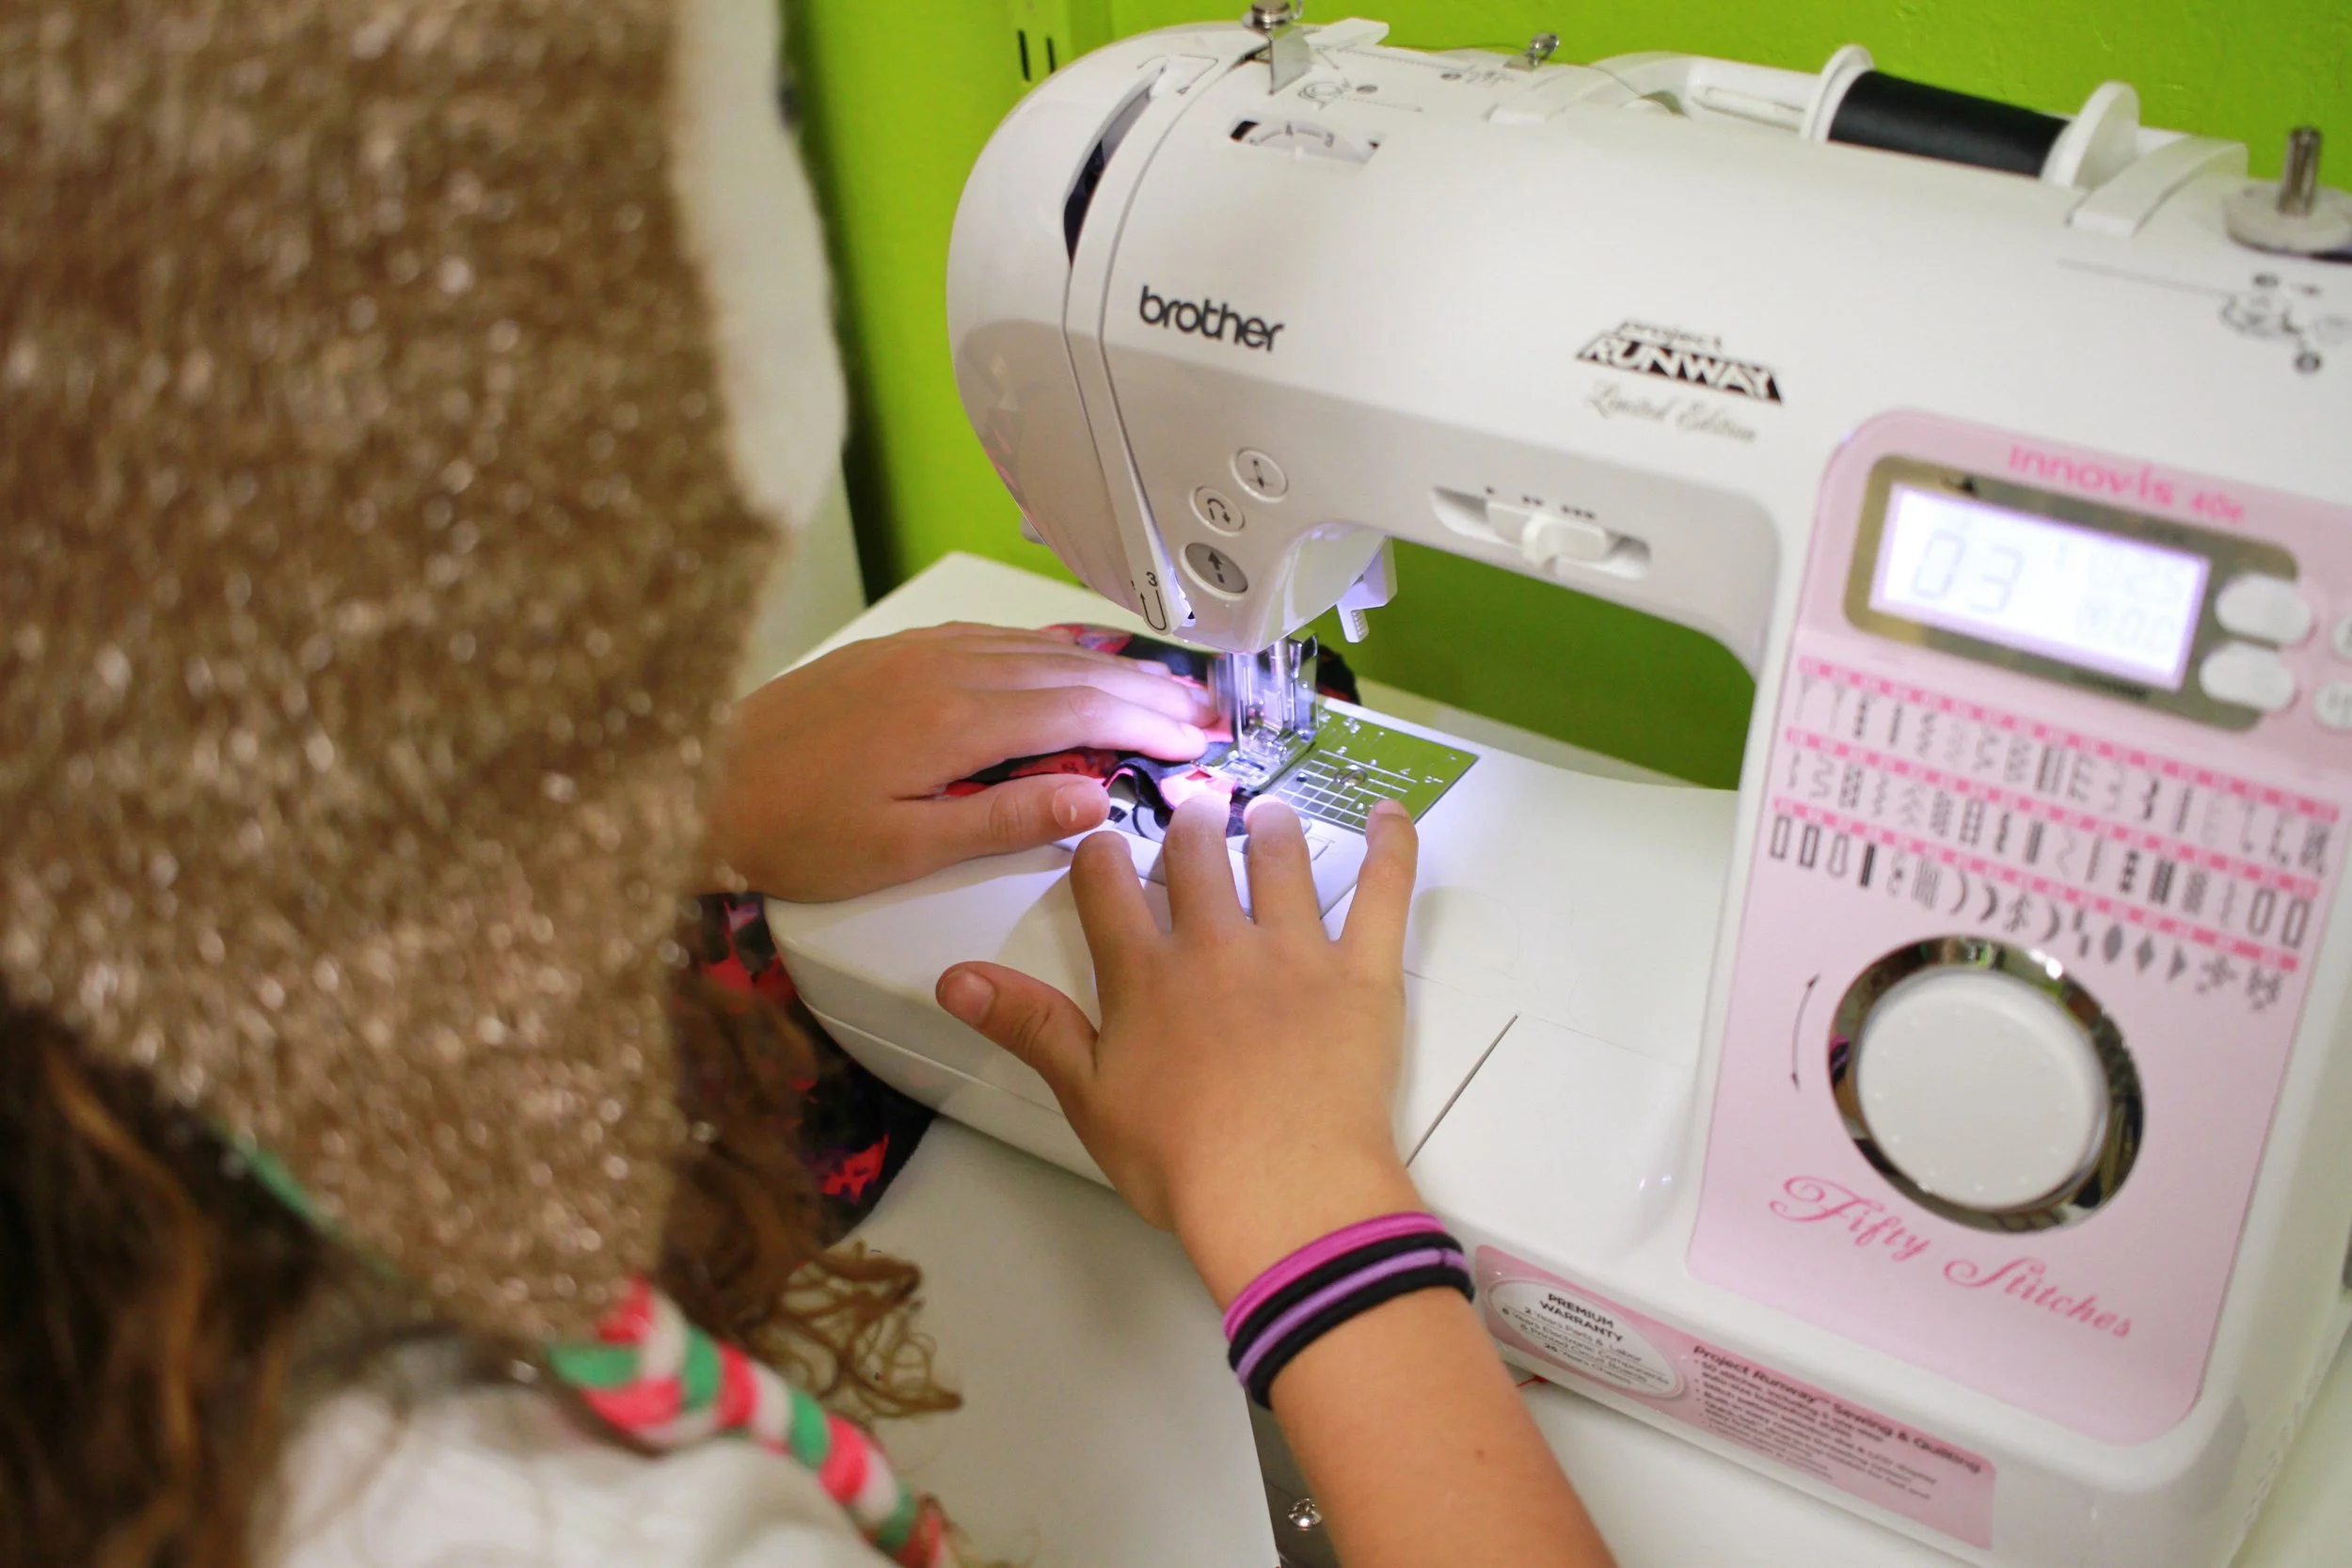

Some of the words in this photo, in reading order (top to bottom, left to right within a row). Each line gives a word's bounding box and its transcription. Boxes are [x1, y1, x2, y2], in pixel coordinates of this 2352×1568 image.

[1139, 285, 1285, 353] brother
[1580, 333, 1780, 404] RUNWAY
[1585, 381, 1681, 420] Limited
[1674, 401, 1756, 443] Edition
[1147, 571, 1158, 587] 3
[1769, 1176, 1931, 1261] Fifty
[1943, 1257, 2132, 1338] Stitches
[1524, 1306, 1531, 1315] 2
[1539, 1299, 1624, 1344] WARRANTY
[1548, 1291, 1614, 1329] PREMIUM
[1693, 1344, 1749, 1376] Project
